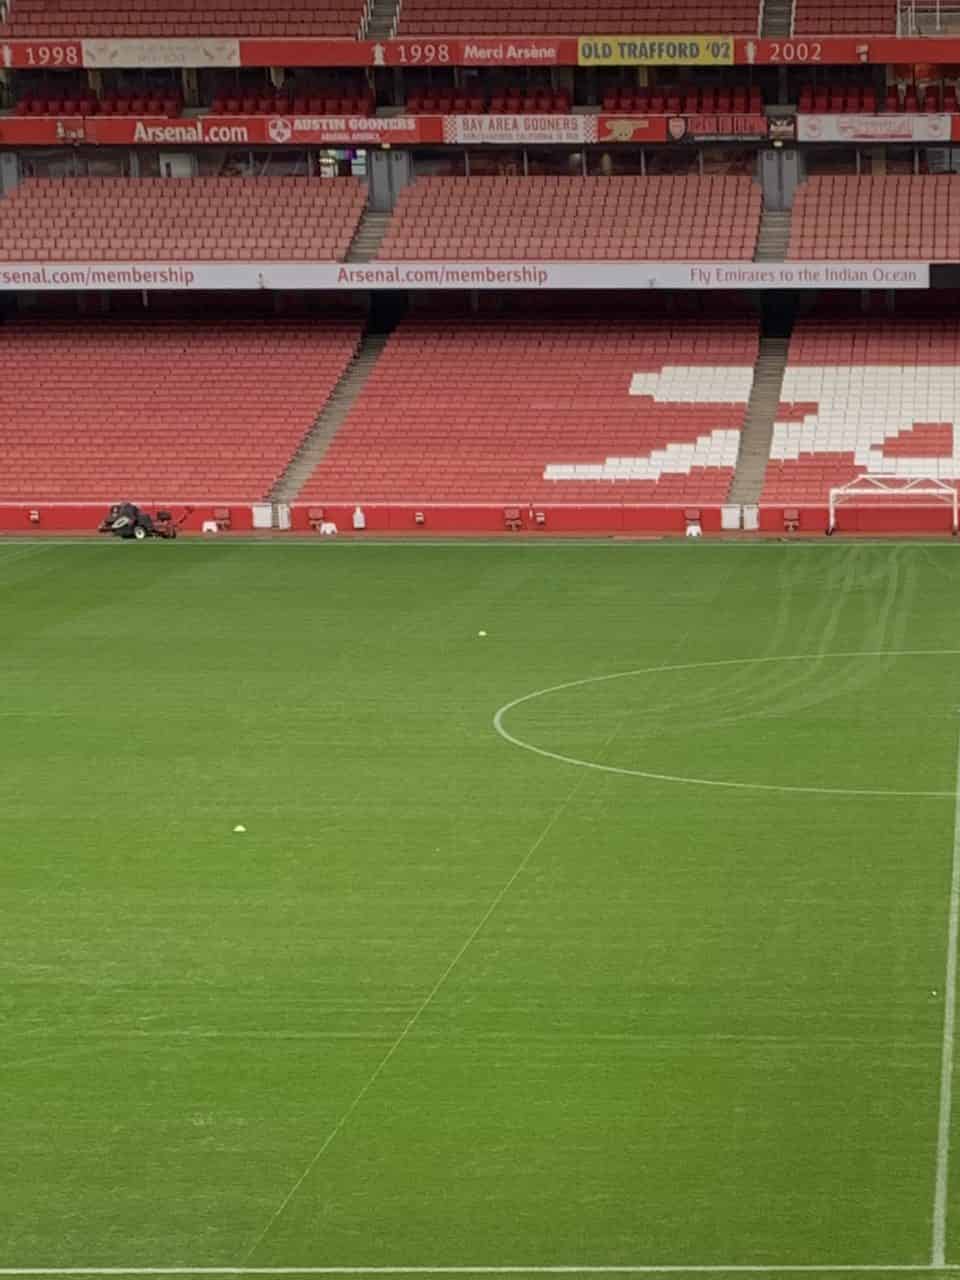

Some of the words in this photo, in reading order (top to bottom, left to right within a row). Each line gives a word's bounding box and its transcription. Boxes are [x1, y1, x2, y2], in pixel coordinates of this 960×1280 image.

[26, 46, 78, 65] 1998
[398, 44, 449, 63] 1998
[581, 42, 612, 59] OLD
[617, 42, 700, 59] TRAFFORD
[769, 43, 822, 61] 2002
[134, 121, 248, 143] Arsenal.com
[294, 118, 345, 130] AUSTIN
[0, 267, 194, 286] senal.com/membership
[337, 267, 549, 286] Arsenal.com/membership
[690, 268, 711, 285] Fly
[715, 268, 775, 282] Emirates
[779, 269, 794, 282] to
[798, 268, 820, 282] the
[824, 268, 868, 282] Indian
[872, 268, 917, 282] Ocean
